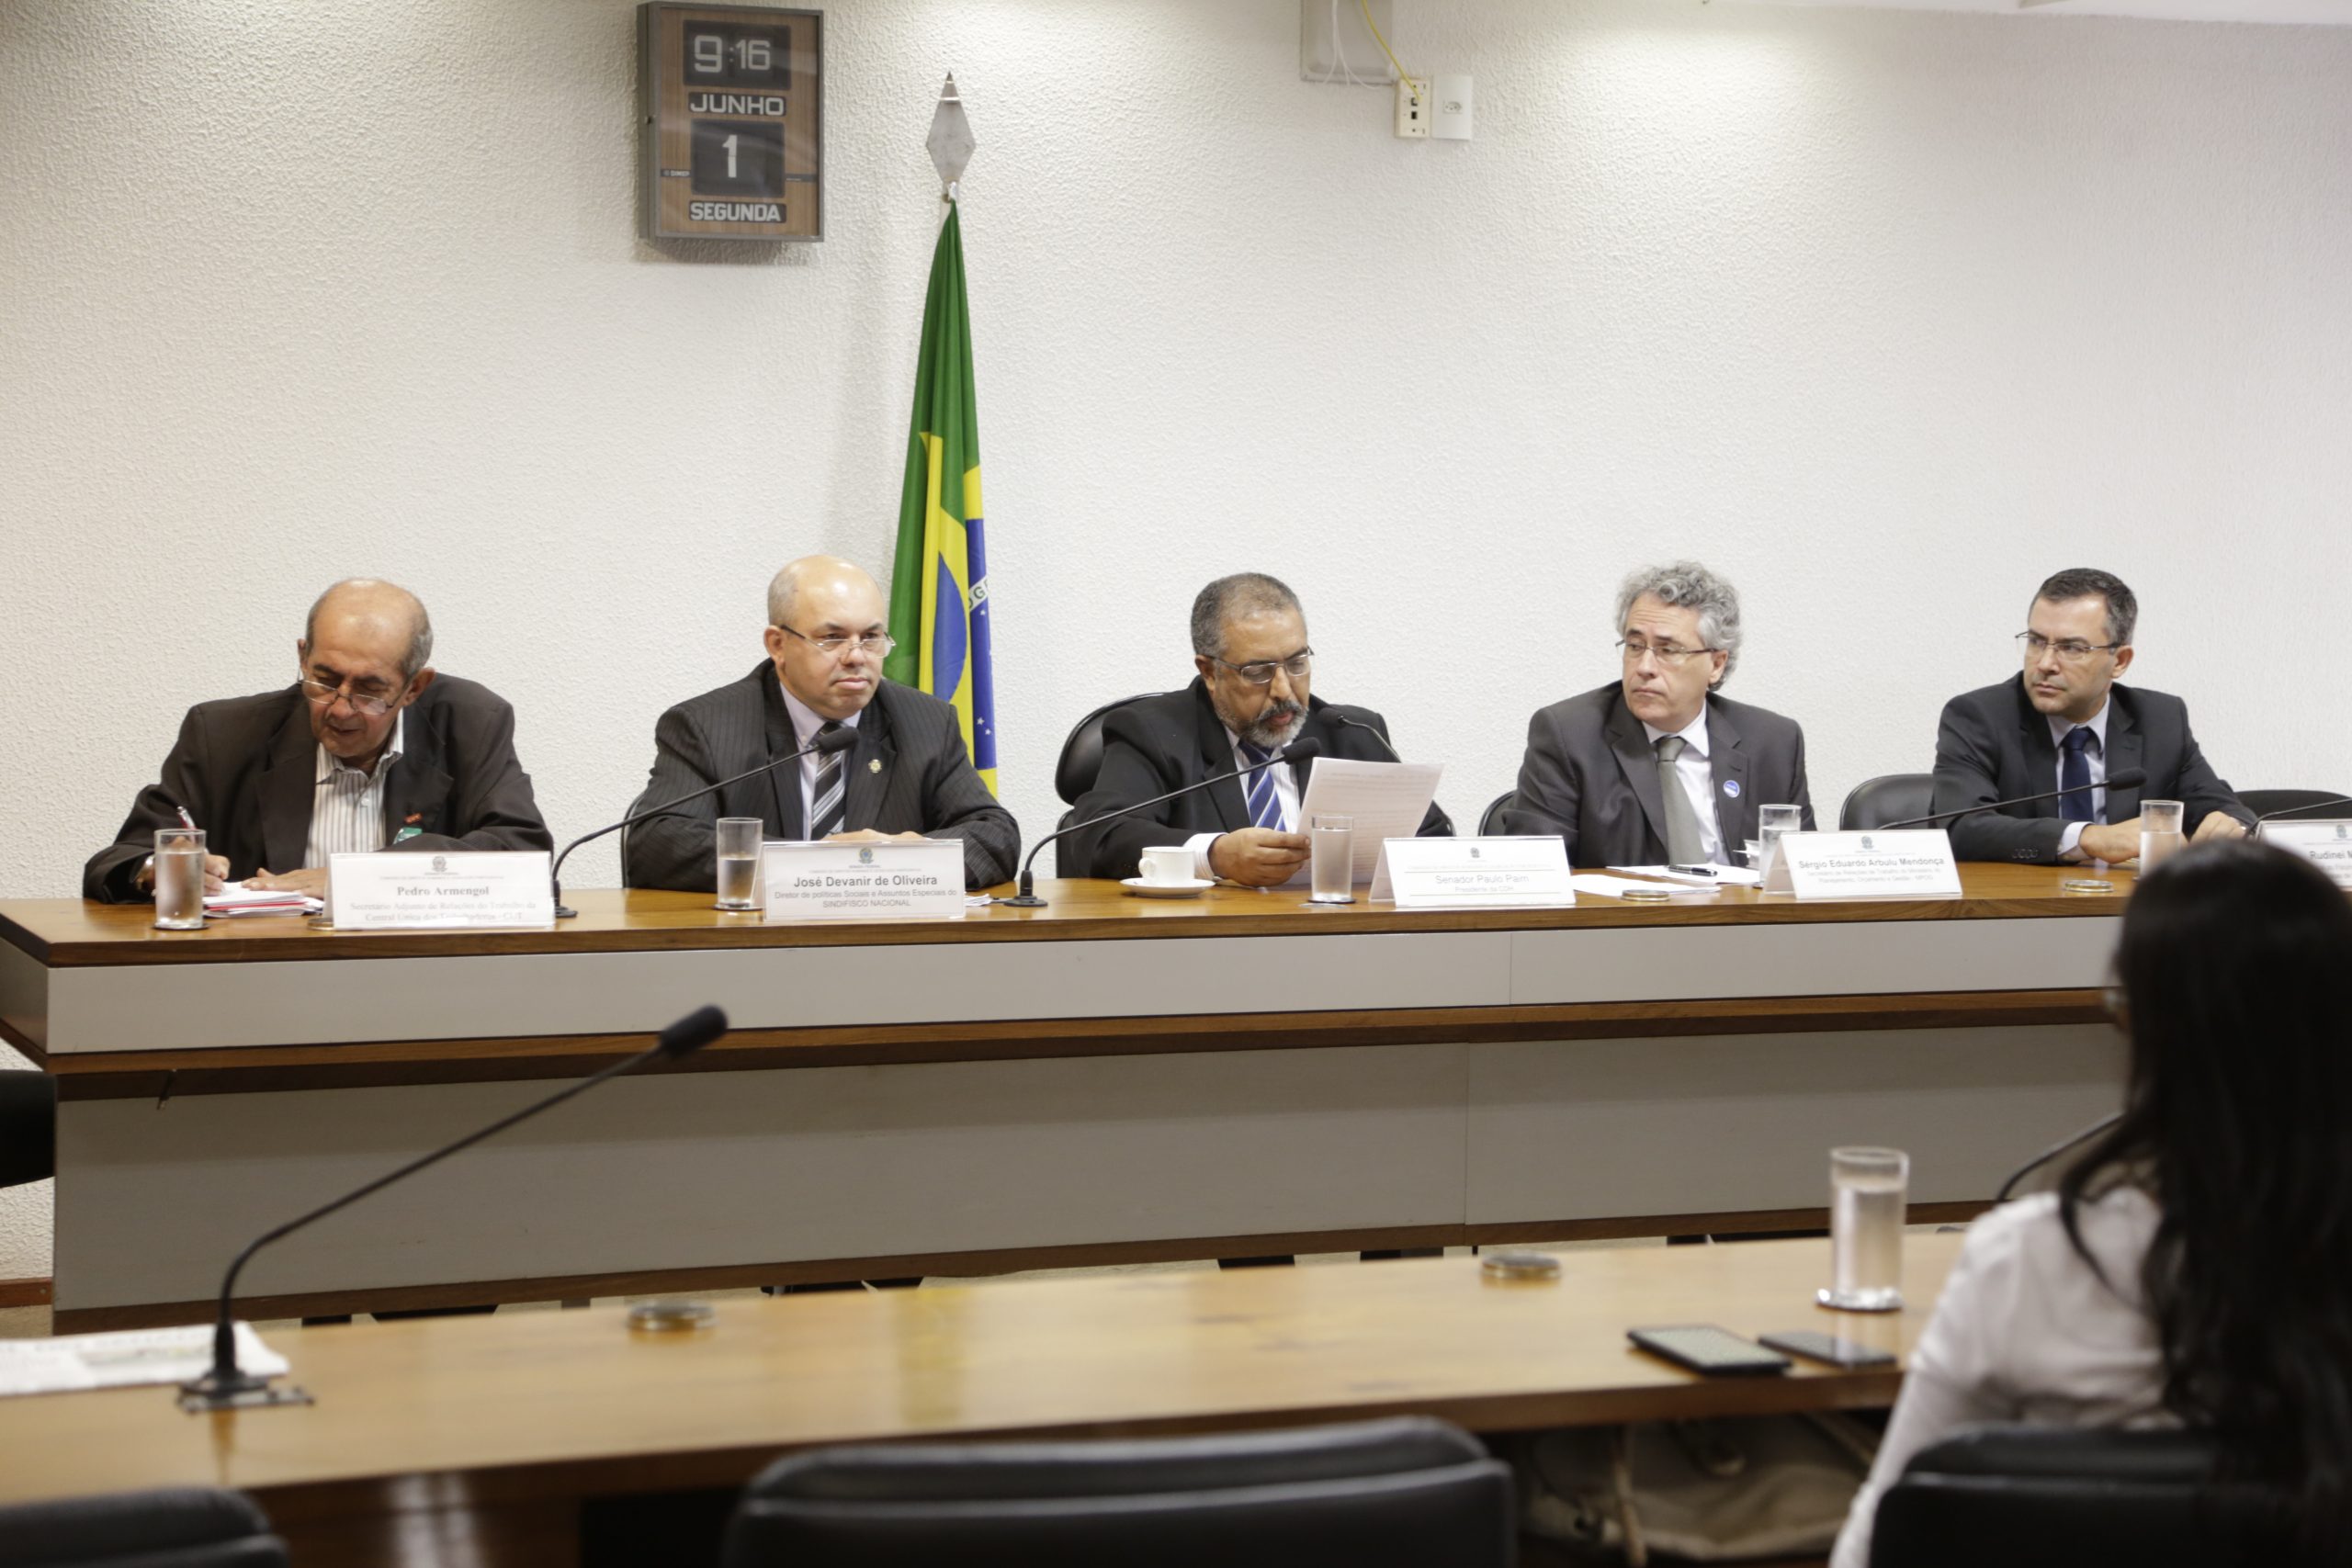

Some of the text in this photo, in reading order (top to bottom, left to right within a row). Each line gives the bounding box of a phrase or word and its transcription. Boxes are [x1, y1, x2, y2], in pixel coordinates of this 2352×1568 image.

[694, 35, 771, 73] 9:16
[690, 94, 785, 116] JUNHO
[722, 134, 738, 178] 1
[690, 202, 782, 222] SEGUNDA
[1829, 859, 1867, 868] Eduardo
[1899, 857, 1945, 867] Mendonça
[794, 874, 938, 888] José Devanir de Oliveira
[1435, 875, 1475, 885] Senador
[1476, 874, 1504, 884] Paulo
[397, 886, 490, 897] Pedro Armengol
[775, 891, 799, 899] Diretor
[843, 889, 870, 897] Sociais
[877, 889, 911, 897] Assuntos
[912, 888, 946, 897] Especiais
[948, 888, 957, 897] do
[870, 899, 911, 908] NACIONAL
